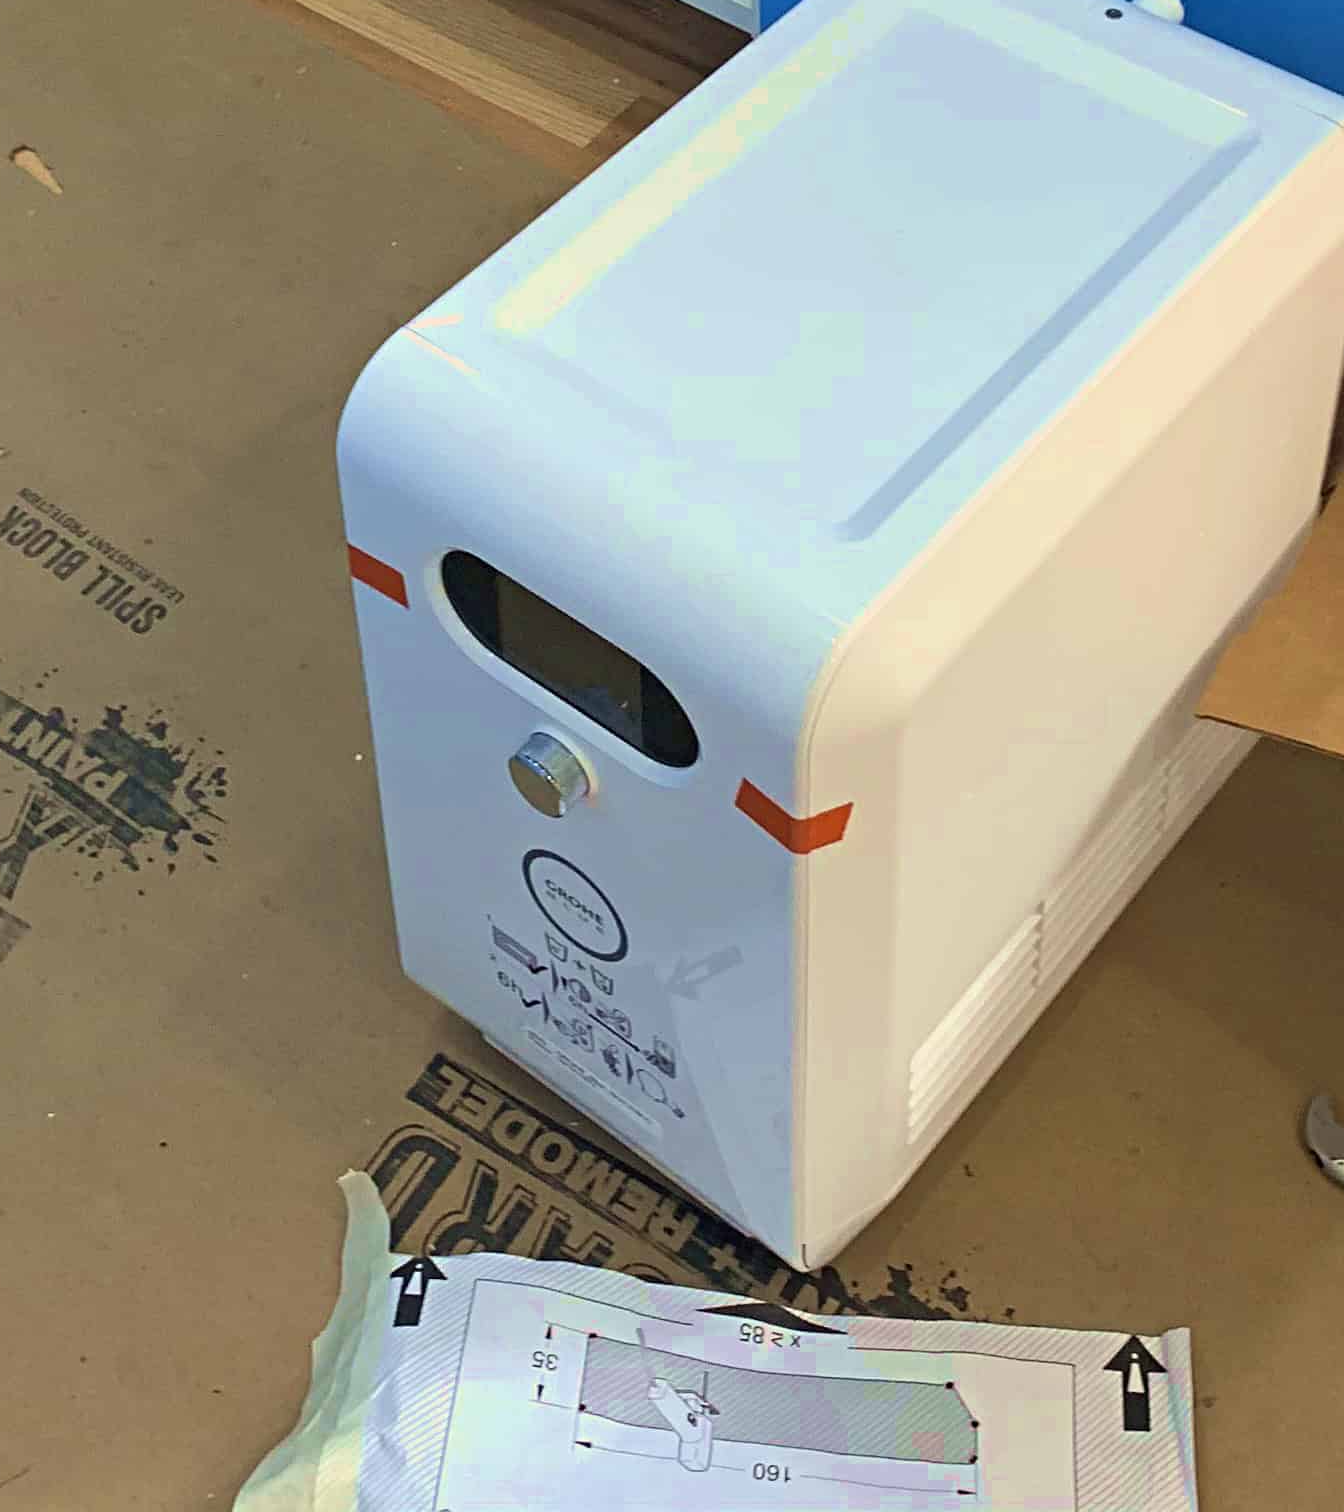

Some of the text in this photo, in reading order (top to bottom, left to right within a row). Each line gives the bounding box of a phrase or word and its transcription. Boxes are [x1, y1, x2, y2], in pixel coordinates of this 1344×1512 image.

[19, 487, 91, 539] PROTECTION
[80, 563, 167, 634] SPILL
[151, 577, 185, 605] LEAK
[434, 1060, 700, 1252] REMODEL
[738, 1322, 765, 1345] 85
[531, 1349, 559, 1371] 35
[752, 1461, 792, 1483] 160
